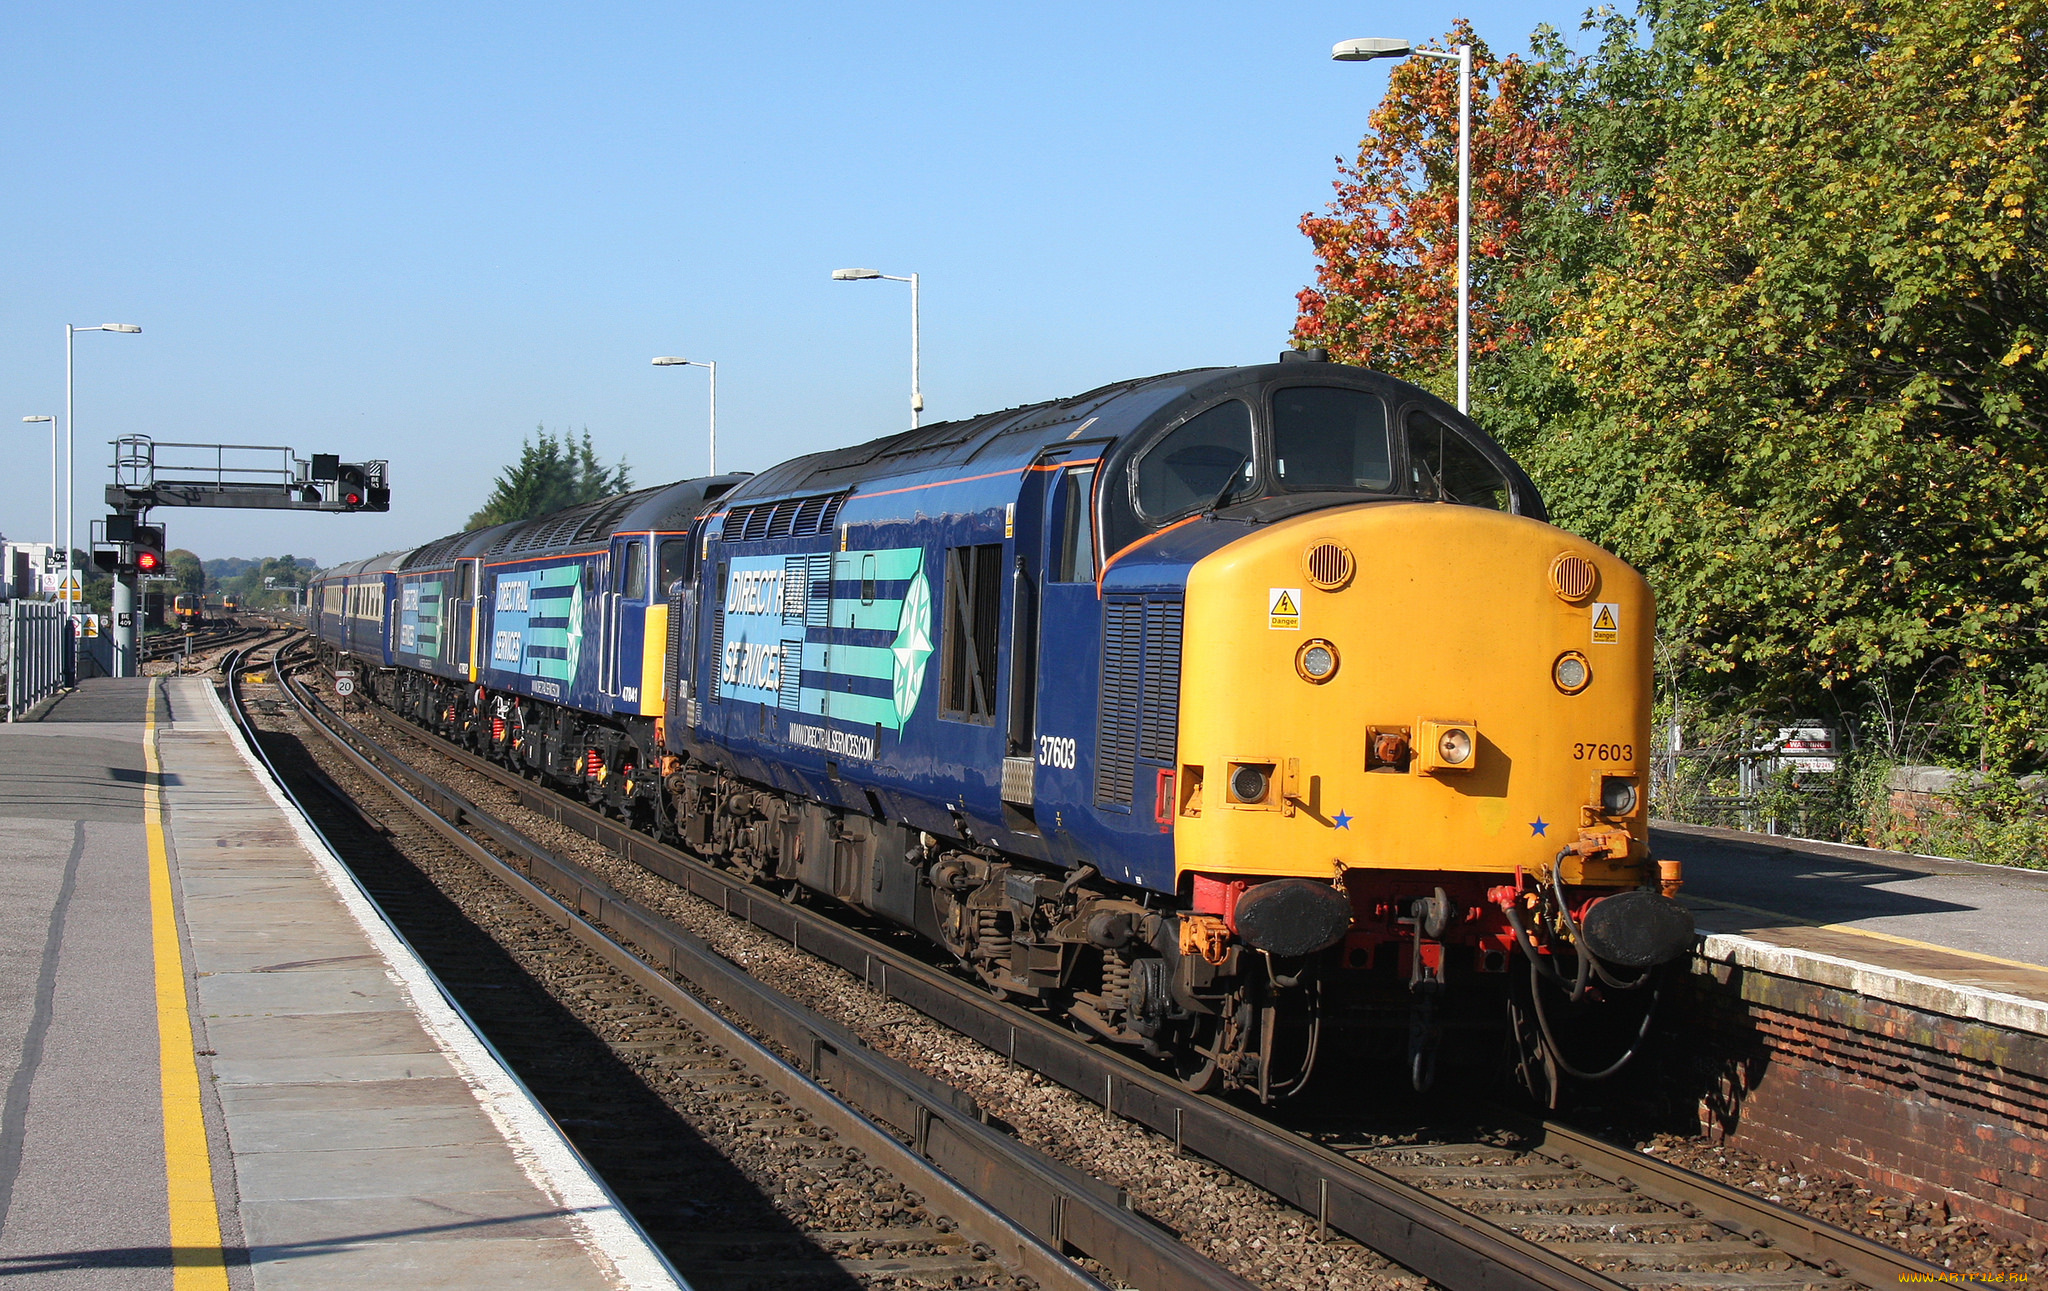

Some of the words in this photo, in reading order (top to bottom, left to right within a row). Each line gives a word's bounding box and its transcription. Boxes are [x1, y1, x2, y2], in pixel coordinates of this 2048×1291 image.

[728, 570, 778, 613] DIRECT
[1271, 617, 1298, 626] Danger
[495, 631, 522, 662] SERVICES
[723, 641, 788, 691] SERVICES
[338, 682, 351, 692] 20
[1039, 735, 1076, 770] 37603
[1573, 742, 1633, 762] 37603
[1790, 741, 1826, 749] WARNING
